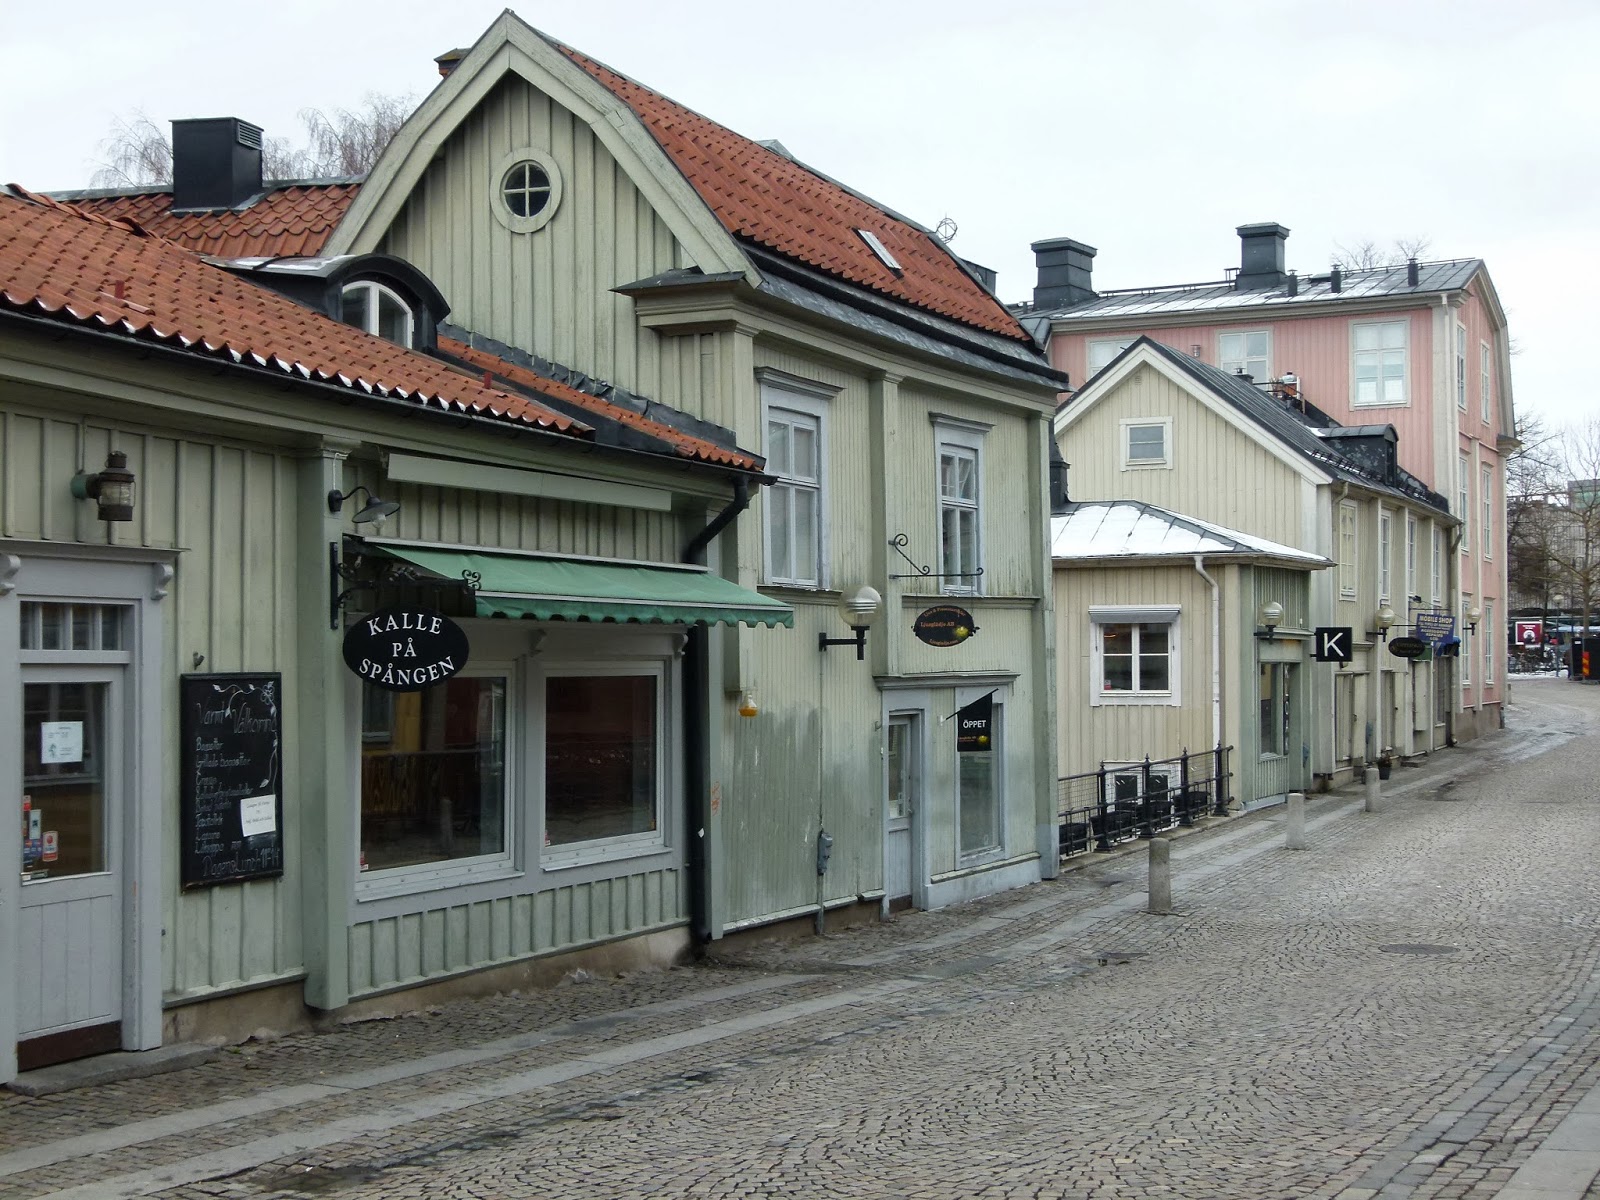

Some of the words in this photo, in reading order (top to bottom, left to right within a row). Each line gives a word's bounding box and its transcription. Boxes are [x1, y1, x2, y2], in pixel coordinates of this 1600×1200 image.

[367, 612, 443, 636] KALLE
[1419, 614, 1438, 623] MOBILE
[1438, 616, 1453, 624] SHOP
[392, 637, 416, 657] PÅ
[1323, 632, 1345, 657] K
[359, 655, 455, 685] SPÅNGEN
[962, 719, 986, 729] ÖPPET
